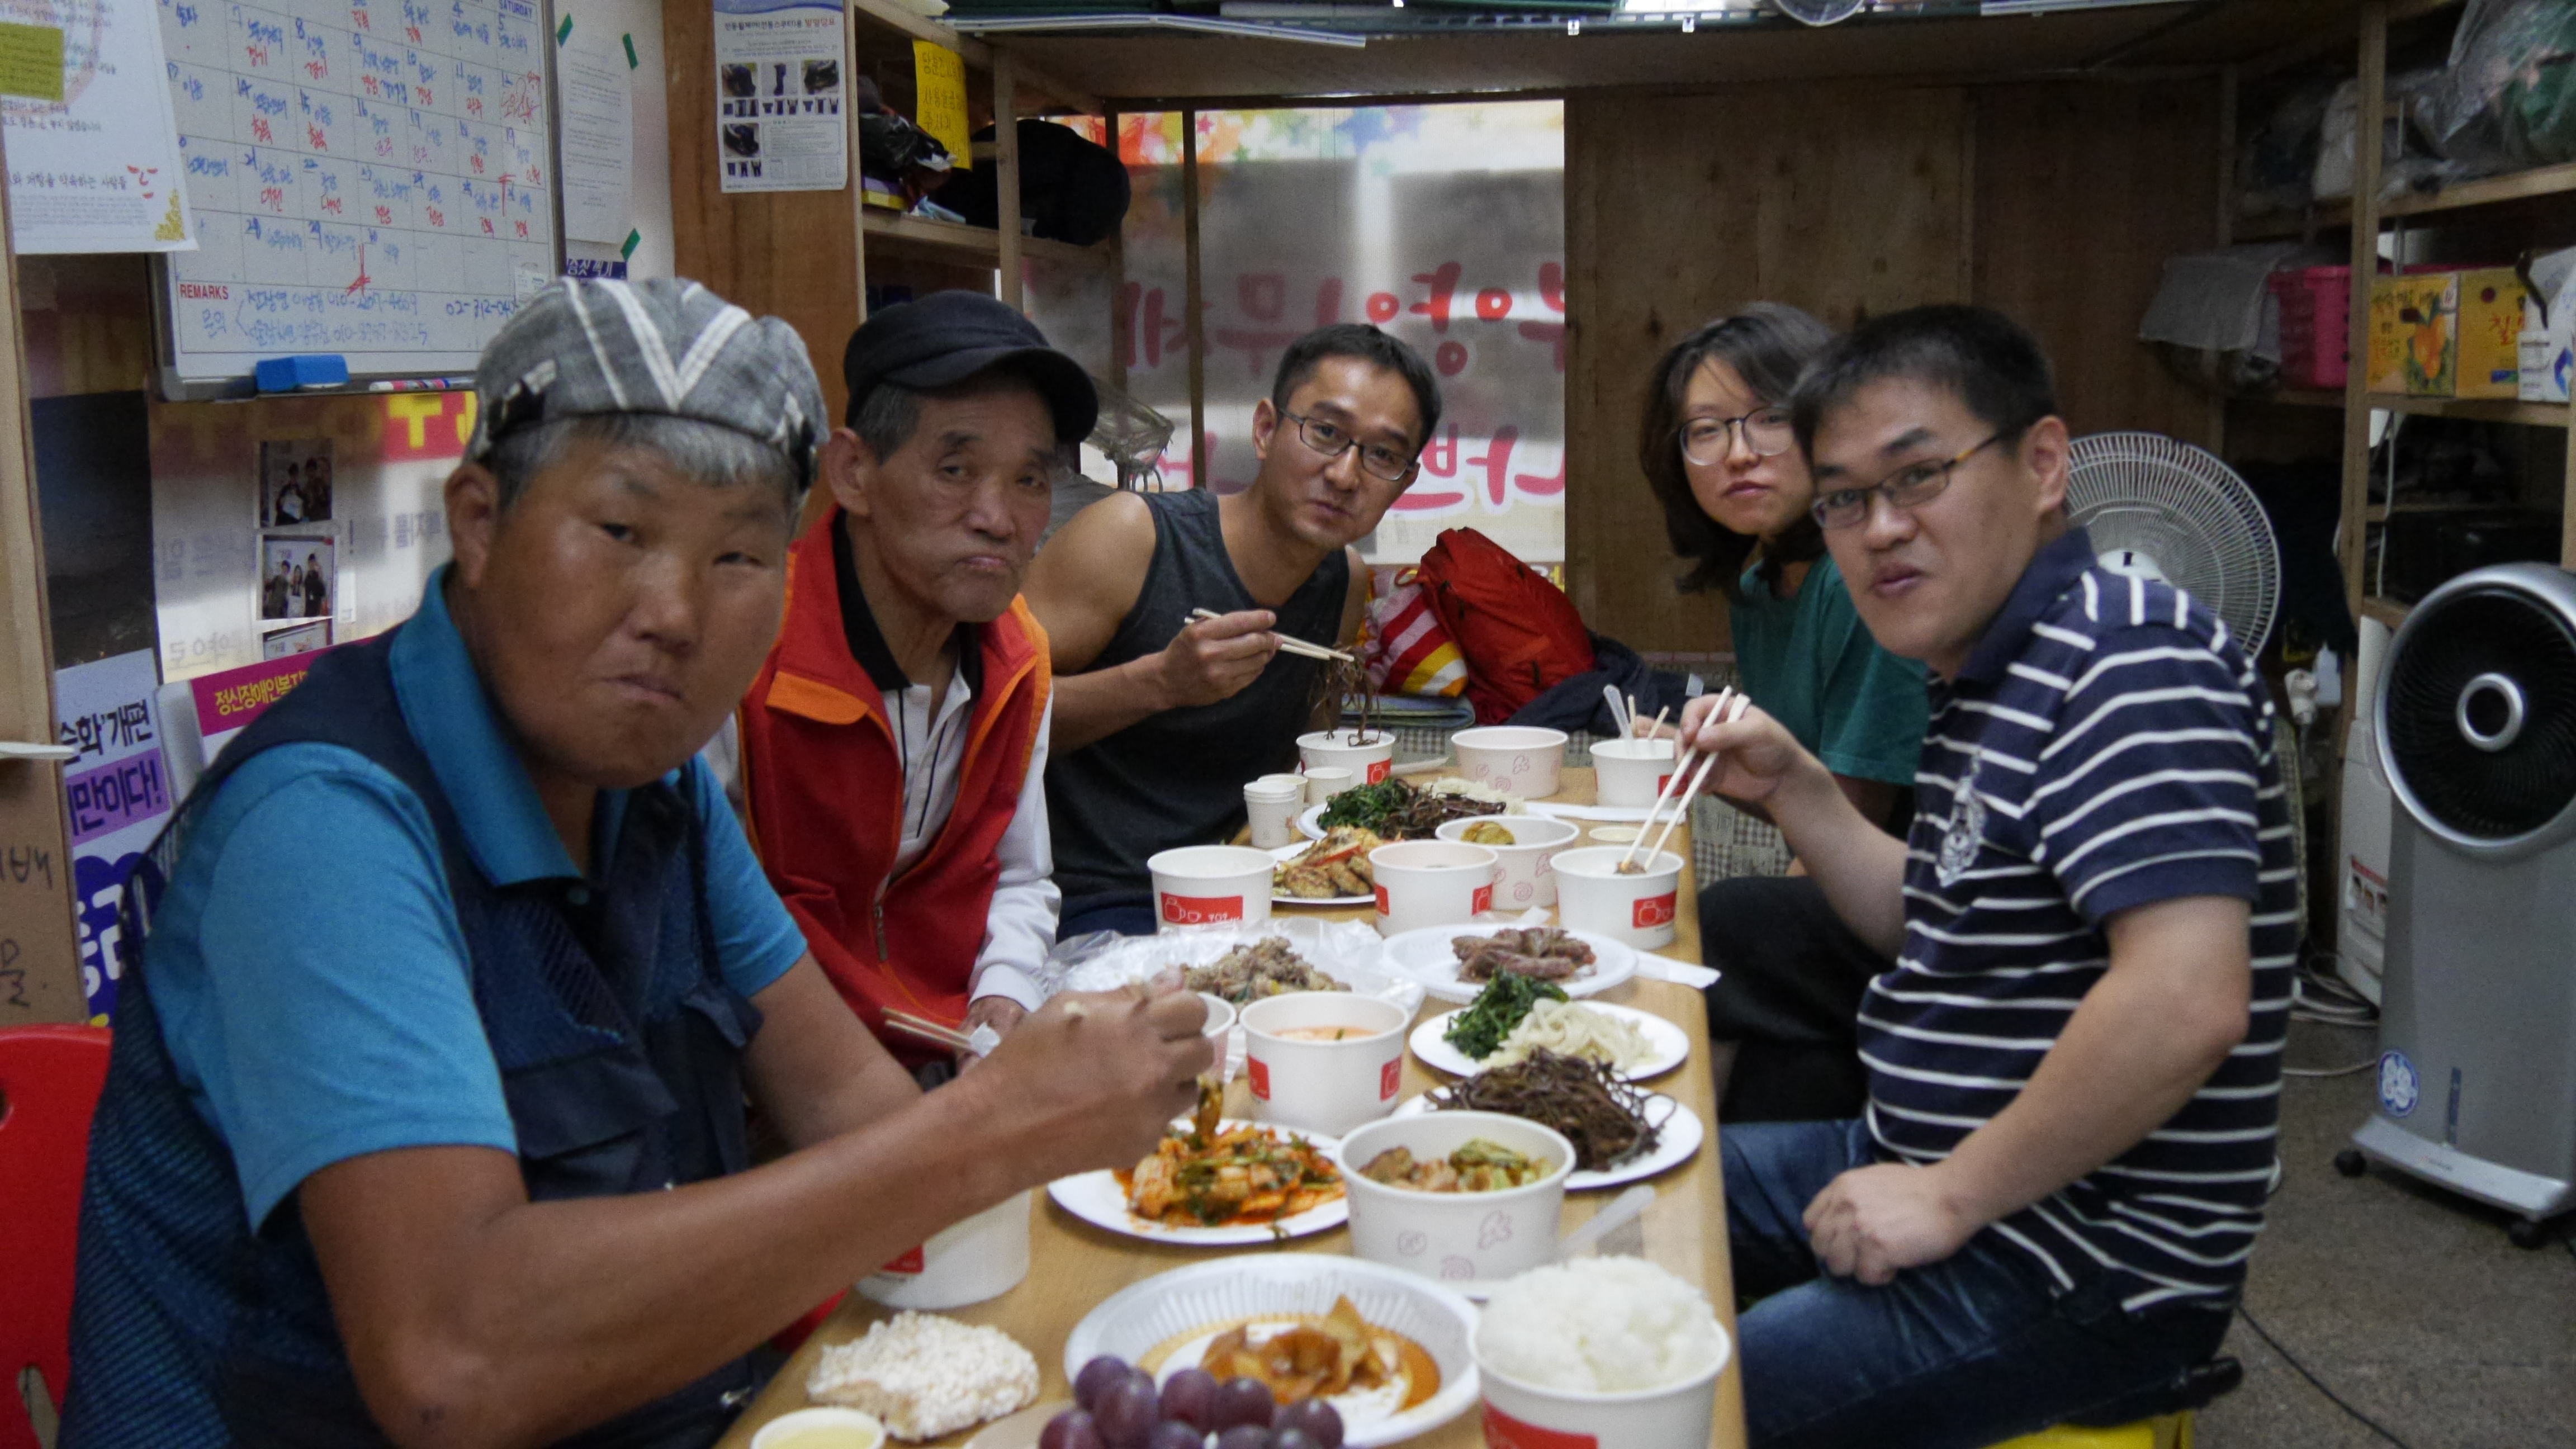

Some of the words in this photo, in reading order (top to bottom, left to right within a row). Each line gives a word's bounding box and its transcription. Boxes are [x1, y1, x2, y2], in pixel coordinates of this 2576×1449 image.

[499, 0, 532, 19] SATURDAY
[295, 17, 305, 40] 8
[498, 12, 505, 31] 5
[180, 283, 229, 300] REMARKS
